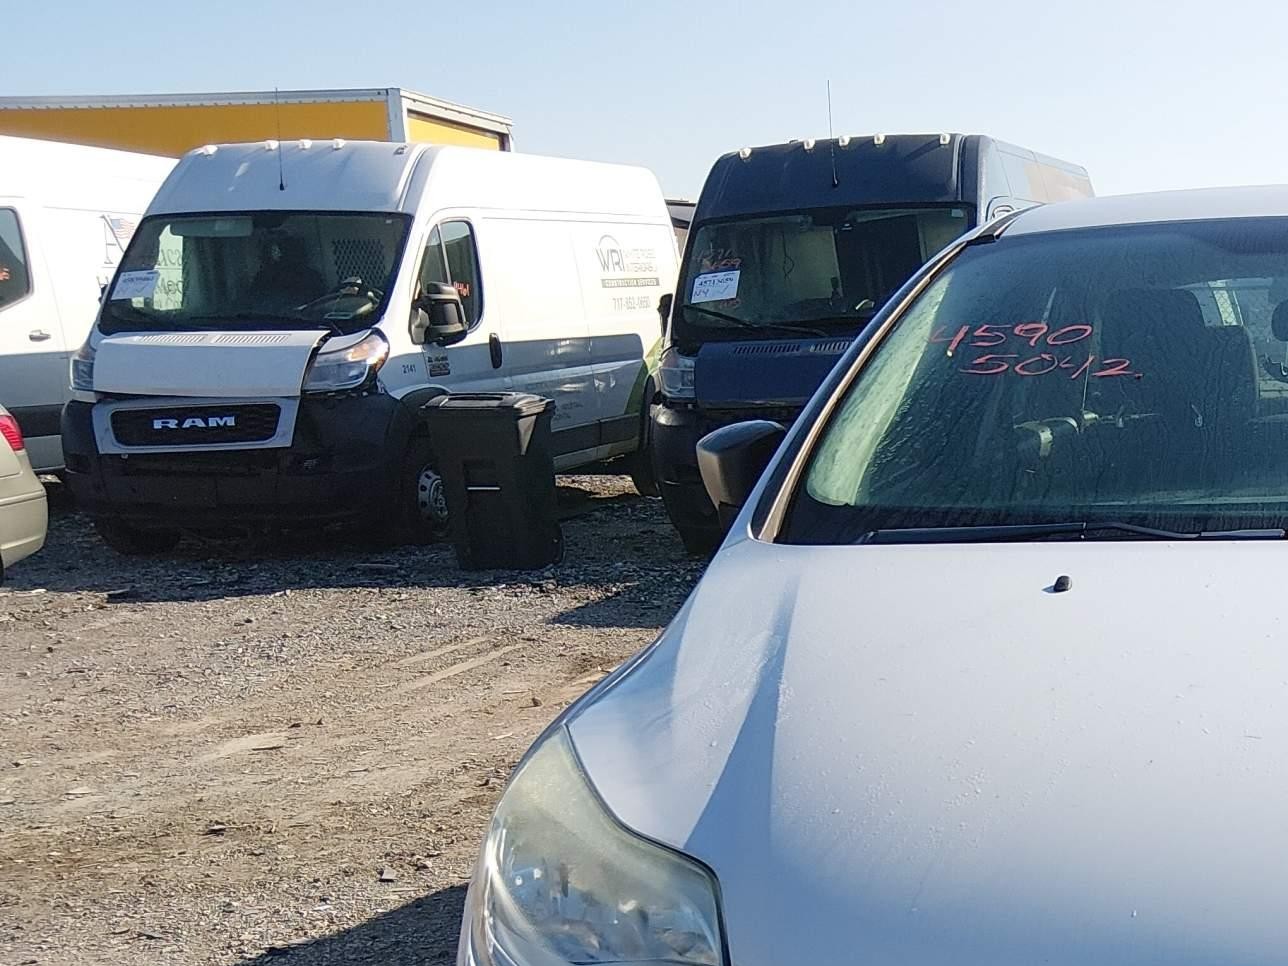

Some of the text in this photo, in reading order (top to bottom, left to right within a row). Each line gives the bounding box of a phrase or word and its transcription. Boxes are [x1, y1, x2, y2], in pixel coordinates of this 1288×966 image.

[595, 247, 625, 272] WRI
[929, 323, 1093, 352] 4590
[153, 416, 236, 429] RAM
